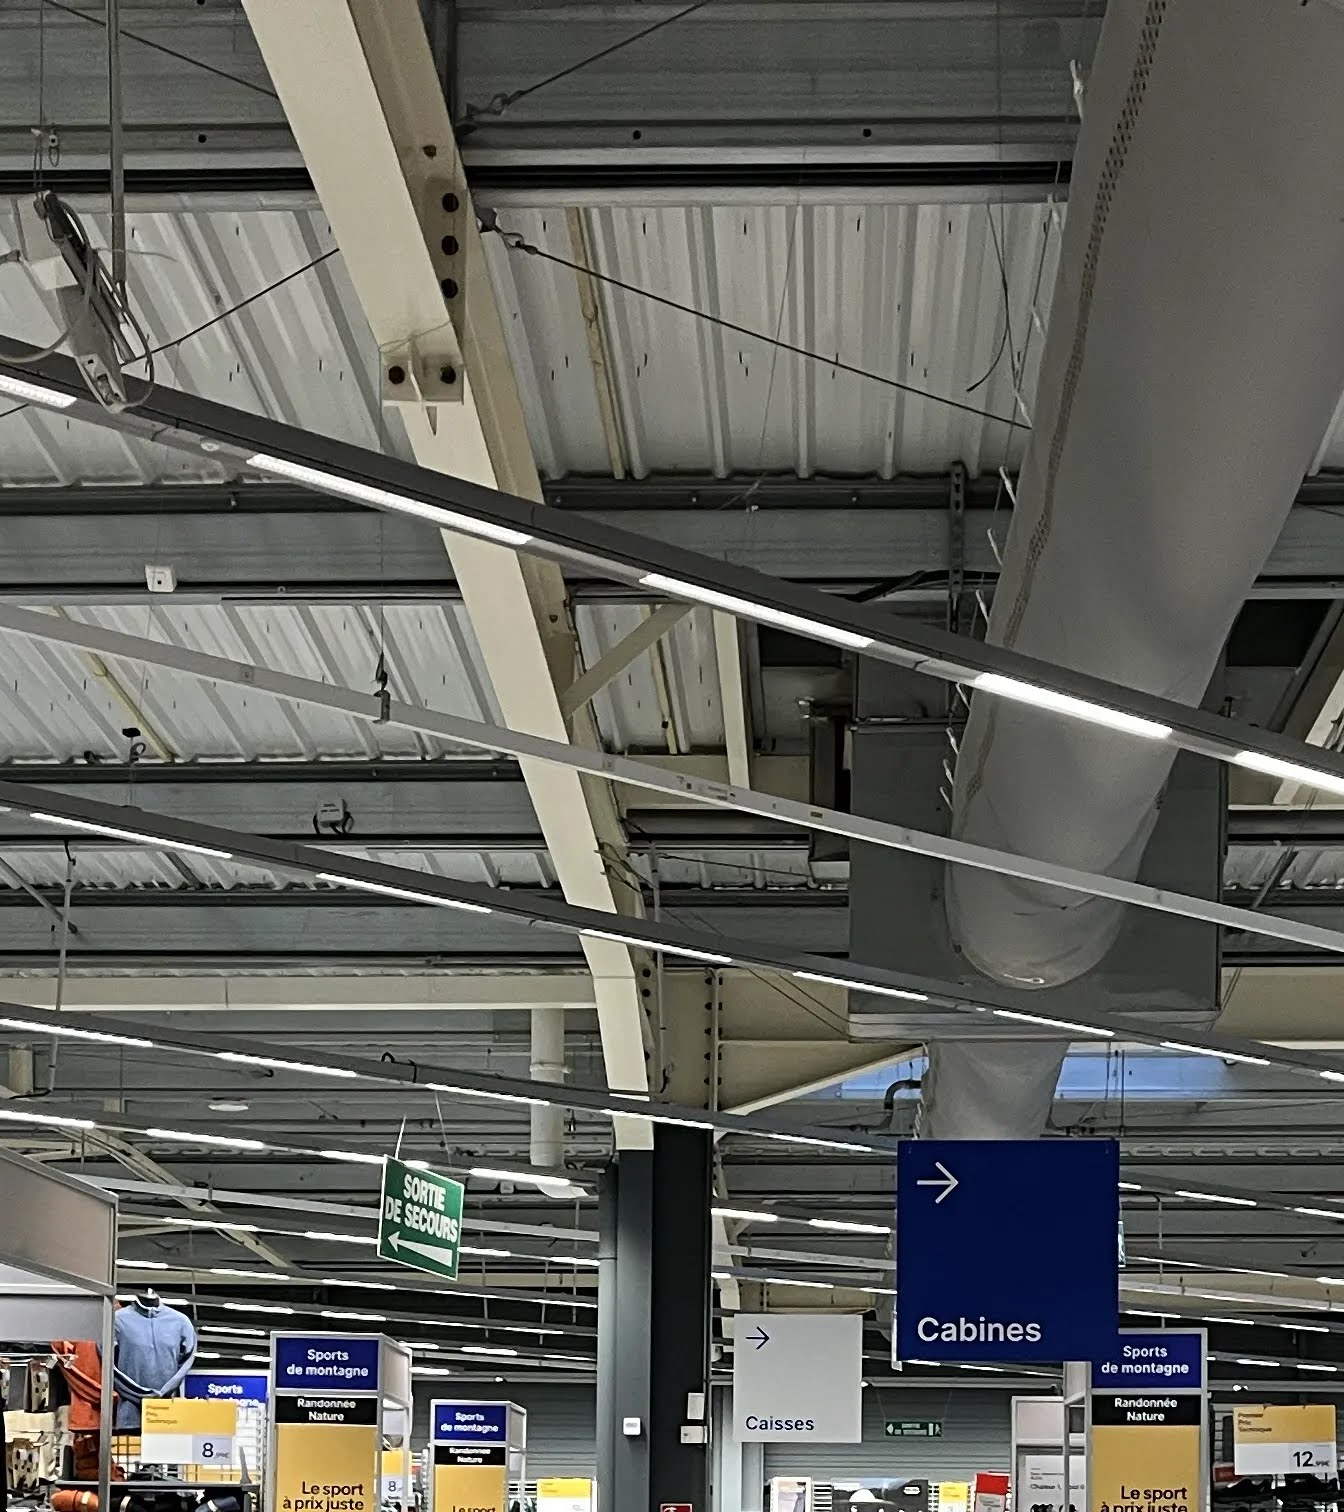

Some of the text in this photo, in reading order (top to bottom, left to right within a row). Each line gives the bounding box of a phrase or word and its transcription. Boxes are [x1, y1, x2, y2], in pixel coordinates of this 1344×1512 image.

[403, 1173, 447, 1212] SORTIE
[384, 1195, 459, 1243] DE SECOURS
[917, 1316, 1042, 1342] Cabines
[307, 1349, 349, 1362] Sports
[1123, 1346, 1168, 1359] Sports
[286, 1363, 369, 1379] de montagne
[1101, 1362, 1190, 1377] de montagne
[207, 1383, 244, 1396] Sports
[297, 1398, 357, 1409] Randonnée
[1114, 1397, 1178, 1408] Randonnée
[308, 1411, 345, 1422] Nature
[455, 1412, 485, 1422] Sports
[745, 1415, 815, 1431] Caisses
[1126, 1411, 1165, 1422] Nature
[440, 1423, 499, 1433] de montagne
[301, 1480, 364, 1498] Le sport
[1120, 1485, 1188, 1503] Le sport
[282, 1496, 365, 1512] à prix juste
